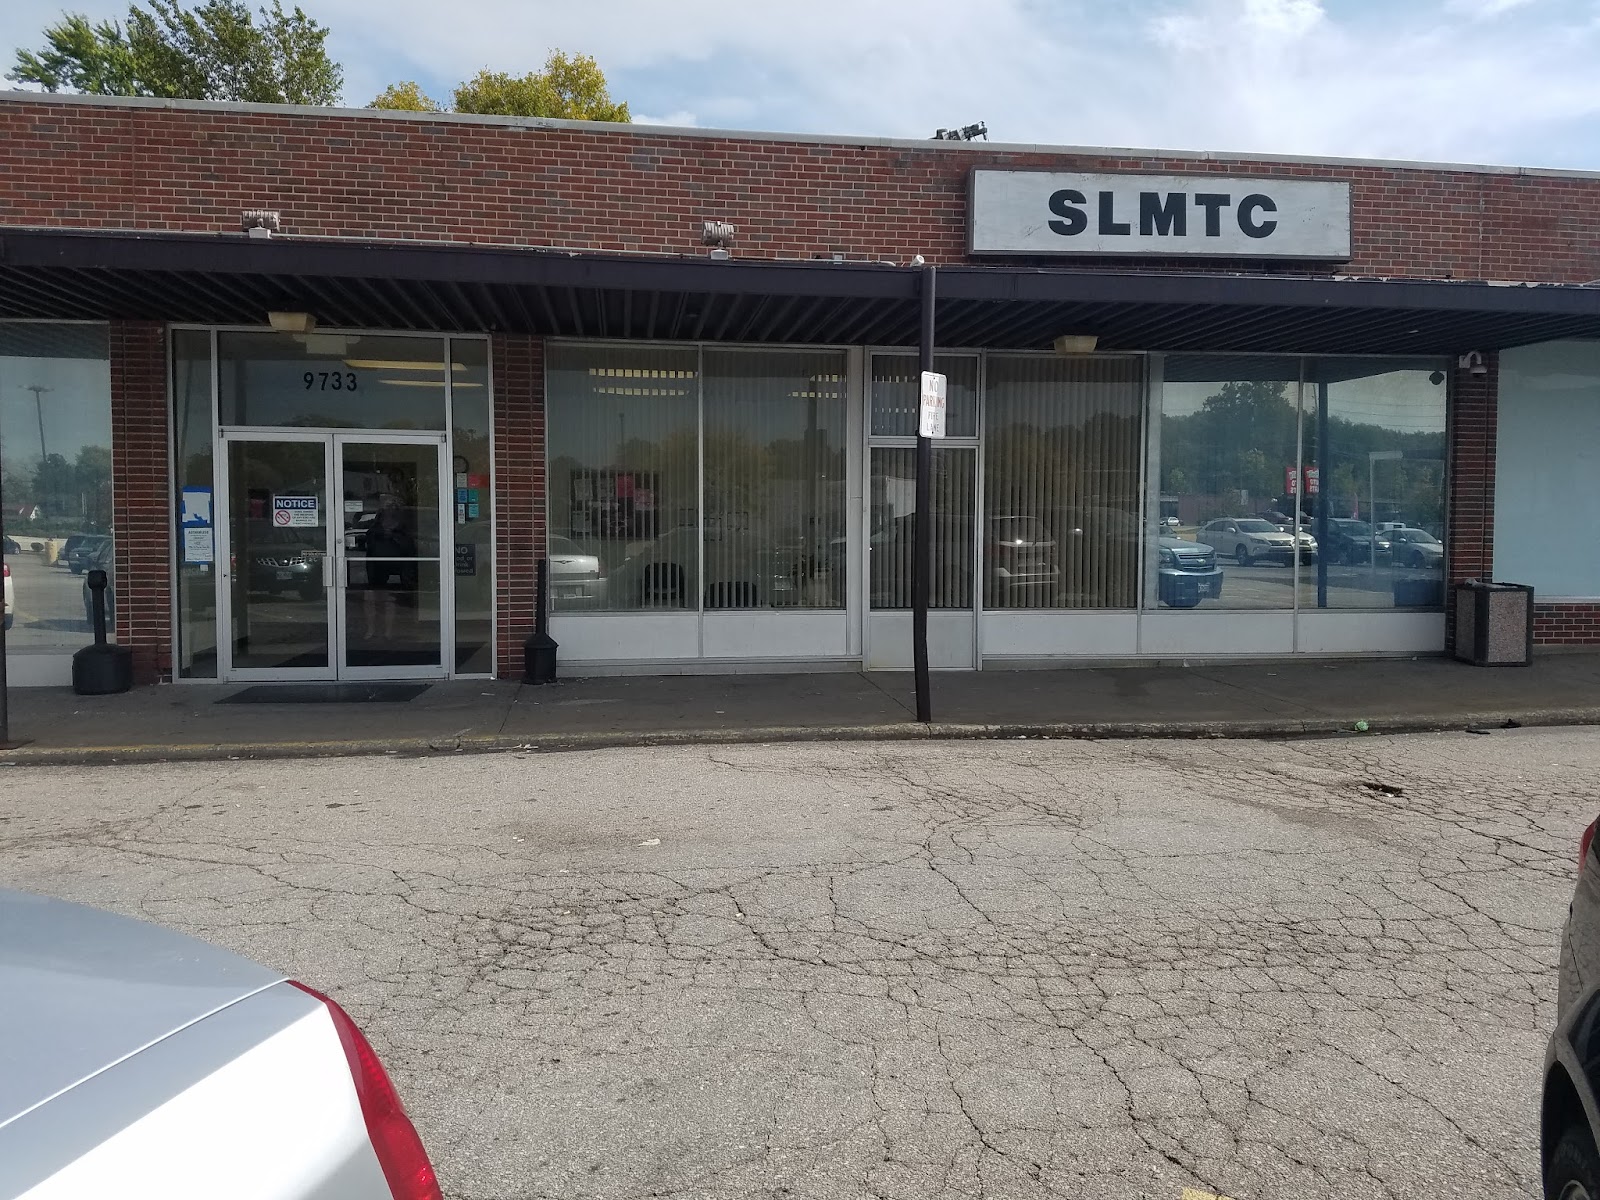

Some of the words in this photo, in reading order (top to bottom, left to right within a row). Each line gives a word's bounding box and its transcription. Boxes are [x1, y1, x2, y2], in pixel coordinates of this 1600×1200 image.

[1047, 188, 1278, 239] SLMTC
[303, 371, 357, 391] 9733
[929, 379, 938, 392] NO
[923, 394, 945, 409] PARKING
[276, 499, 316, 508] NOTICE
